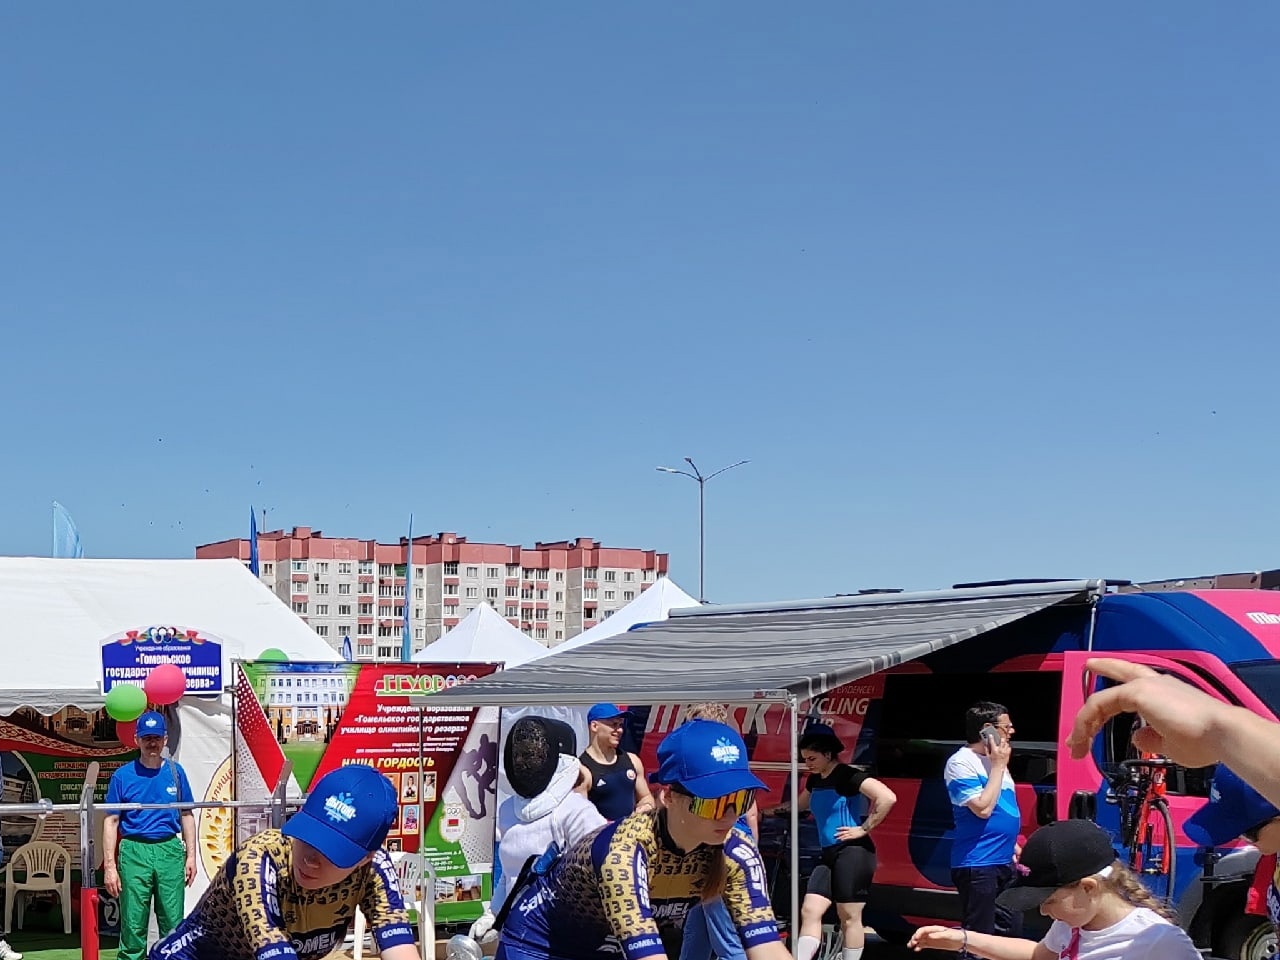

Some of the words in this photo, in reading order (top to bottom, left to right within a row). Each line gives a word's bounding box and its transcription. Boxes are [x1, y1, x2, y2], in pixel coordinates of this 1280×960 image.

[135, 653, 192, 665] «Гомельское
[105, 666, 153, 679] государст
[185, 679, 214, 689] зерва»
[797, 697, 870, 715] CYCLING
[106, 901, 117, 922] 2
